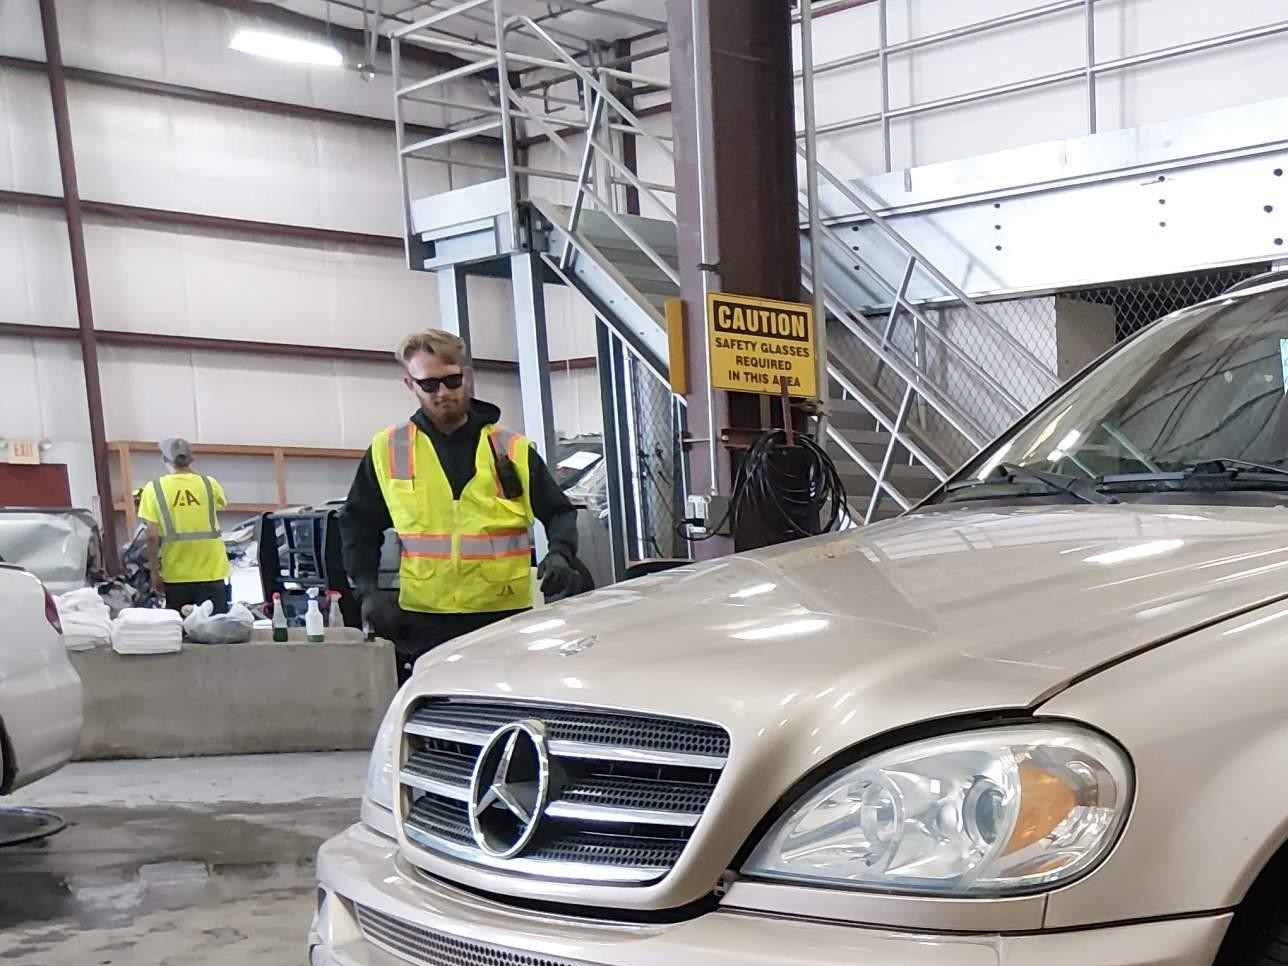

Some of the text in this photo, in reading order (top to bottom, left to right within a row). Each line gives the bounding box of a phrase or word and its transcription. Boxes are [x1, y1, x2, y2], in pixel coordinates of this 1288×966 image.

[718, 305, 805, 338] CAUTION
[715, 337, 810, 358] SAFETY GLASSES
[735, 355, 792, 371] REQUIRED
[728, 370, 740, 381] IN
[743, 371, 769, 385] THIS
